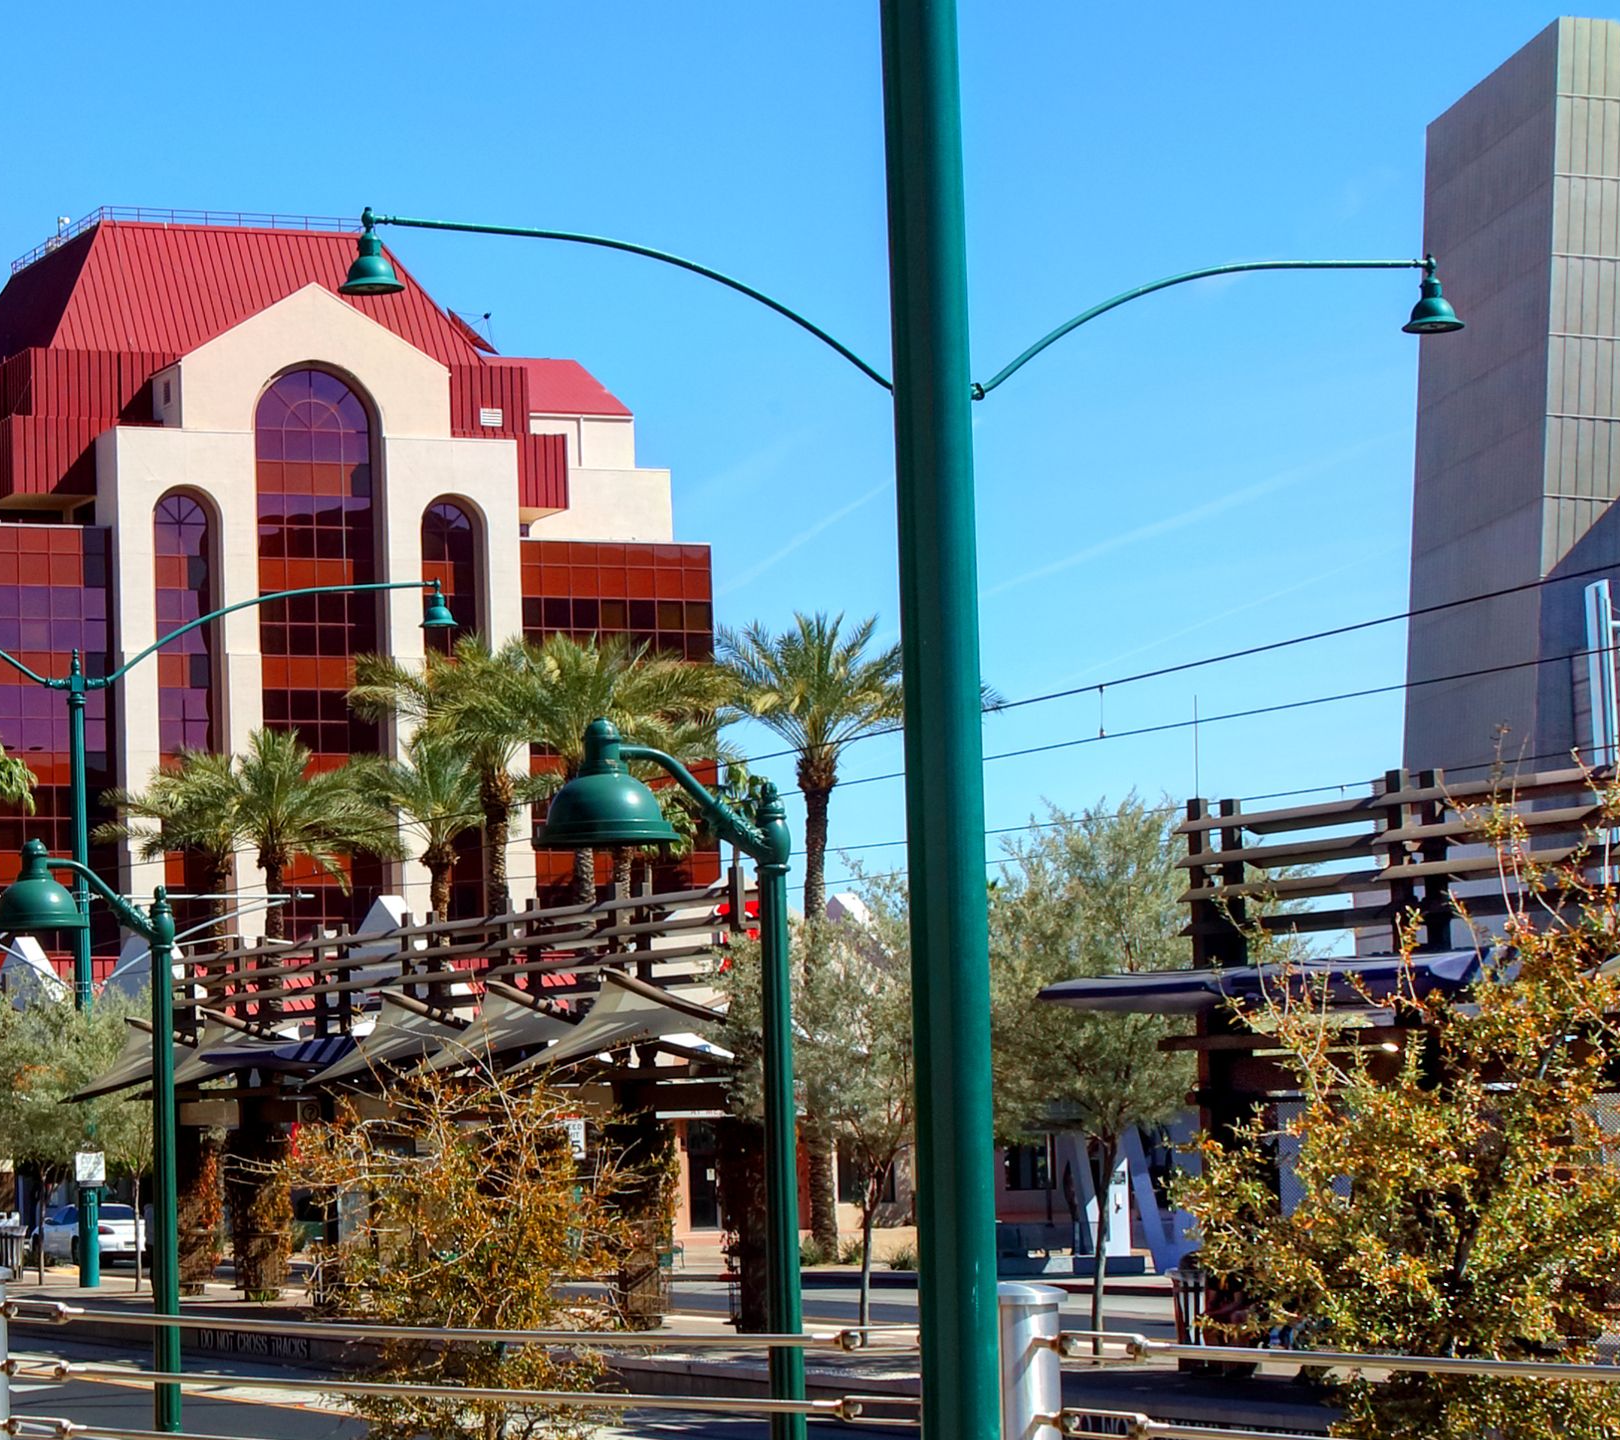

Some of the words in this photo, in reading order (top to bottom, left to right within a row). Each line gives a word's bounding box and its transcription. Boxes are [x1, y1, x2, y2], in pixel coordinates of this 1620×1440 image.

[200, 1329, 214, 1349] DO
[216, 1330, 235, 1352] NOT
[237, 1332, 268, 1355] CROSS
[271, 1336, 308, 1358] TRACKS
